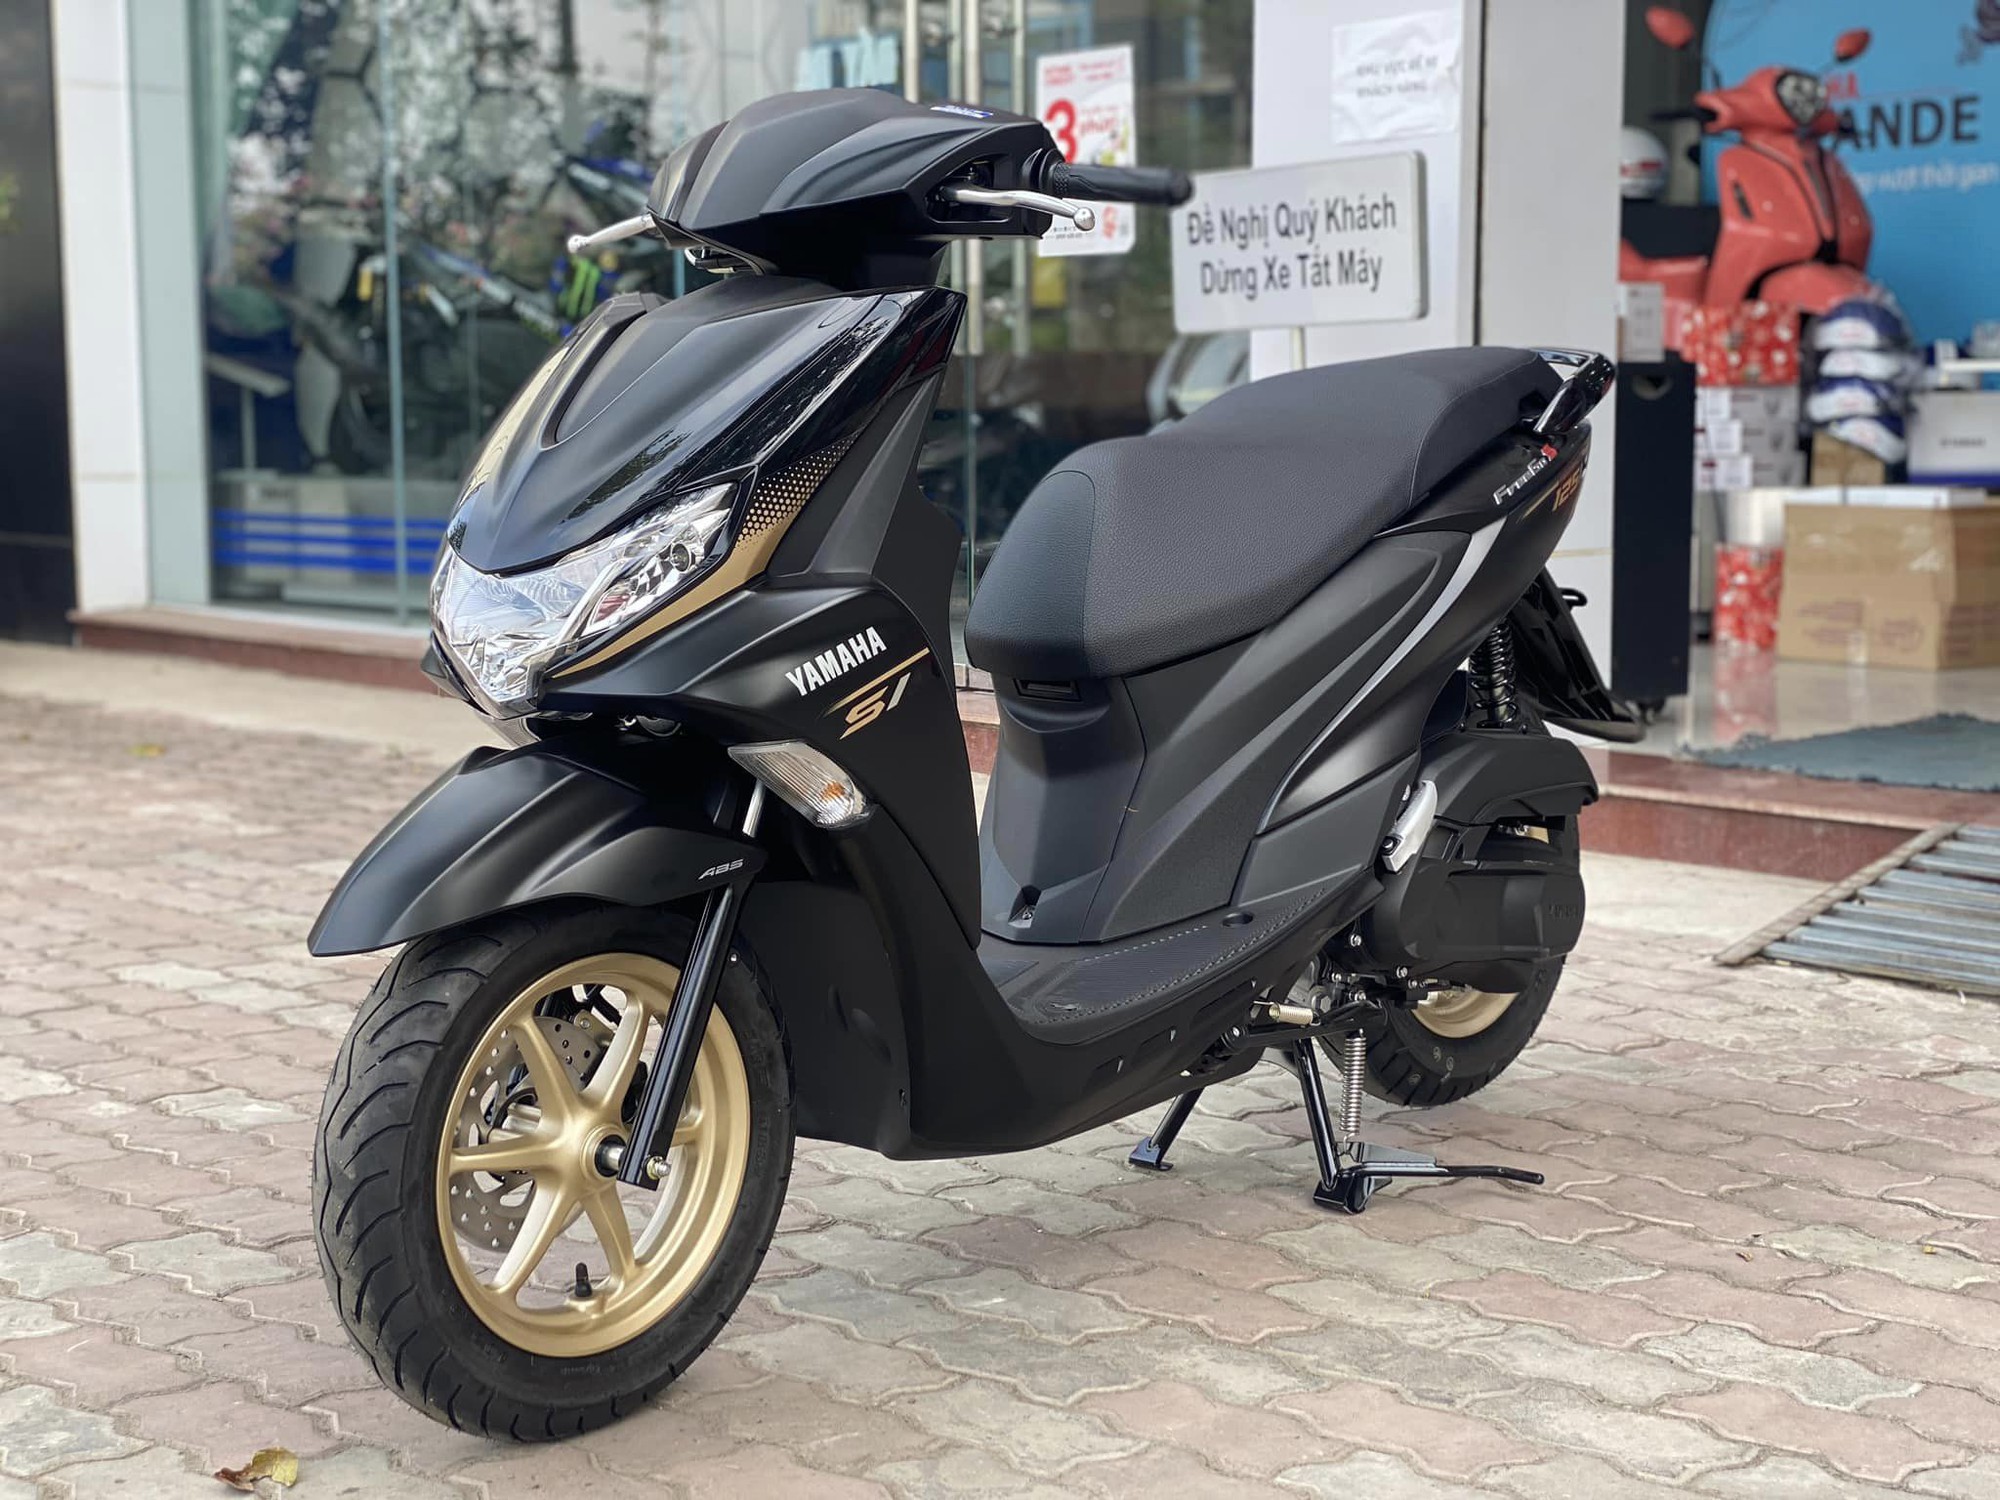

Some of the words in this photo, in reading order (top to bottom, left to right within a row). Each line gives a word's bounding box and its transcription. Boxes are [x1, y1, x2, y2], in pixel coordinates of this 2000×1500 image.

[1832, 96, 1980, 151] ANDE
[1220, 205, 1269, 250] Nghị
[1275, 199, 1318, 244] Quý
[1325, 193, 1396, 234] Khách
[1201, 258, 1258, 301] Dừng
[1263, 256, 1290, 291] Xe
[1338, 247, 1382, 293] Máy
[785, 626, 887, 697] YAMAHA
[698, 858, 744, 880] ABS
